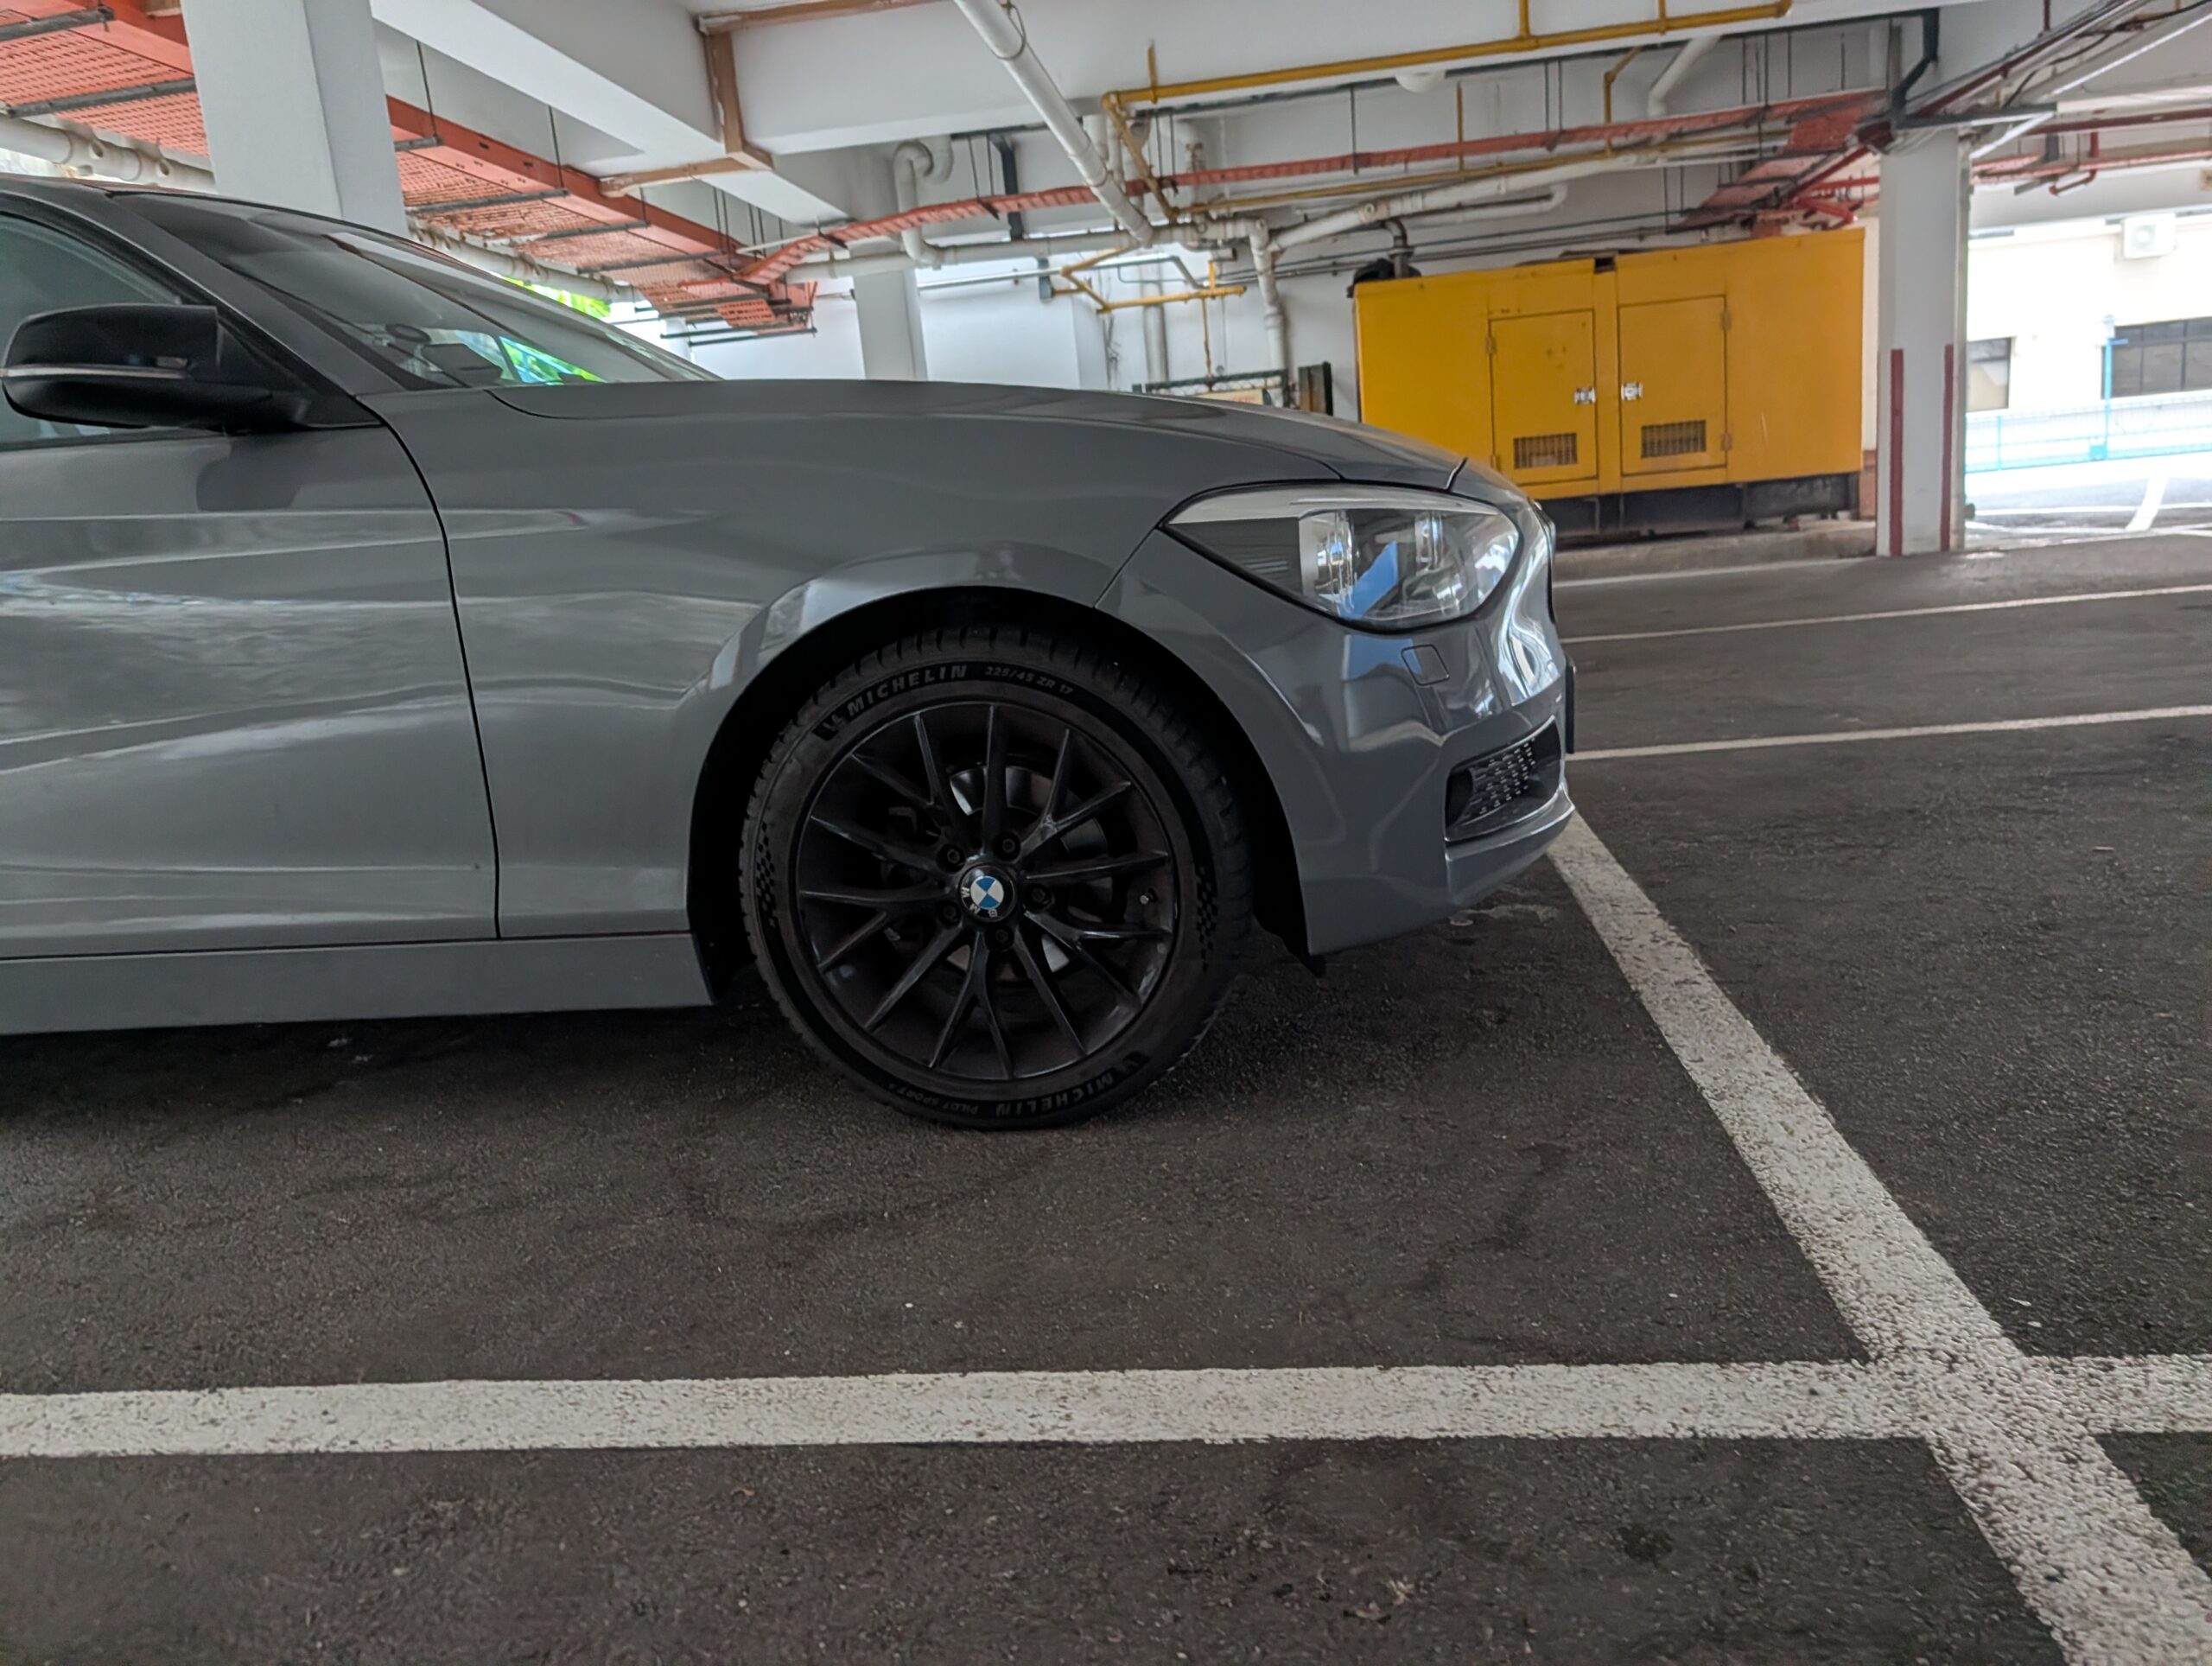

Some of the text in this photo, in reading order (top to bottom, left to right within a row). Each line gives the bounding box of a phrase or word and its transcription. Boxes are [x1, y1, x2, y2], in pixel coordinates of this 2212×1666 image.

[847, 664, 1074, 717] MICHELIN 225/45 ZR 17
[961, 887, 998, 918] BMW
[942, 1101, 979, 1115] PILOT
[995, 1071, 1114, 1117] MICHELIN
